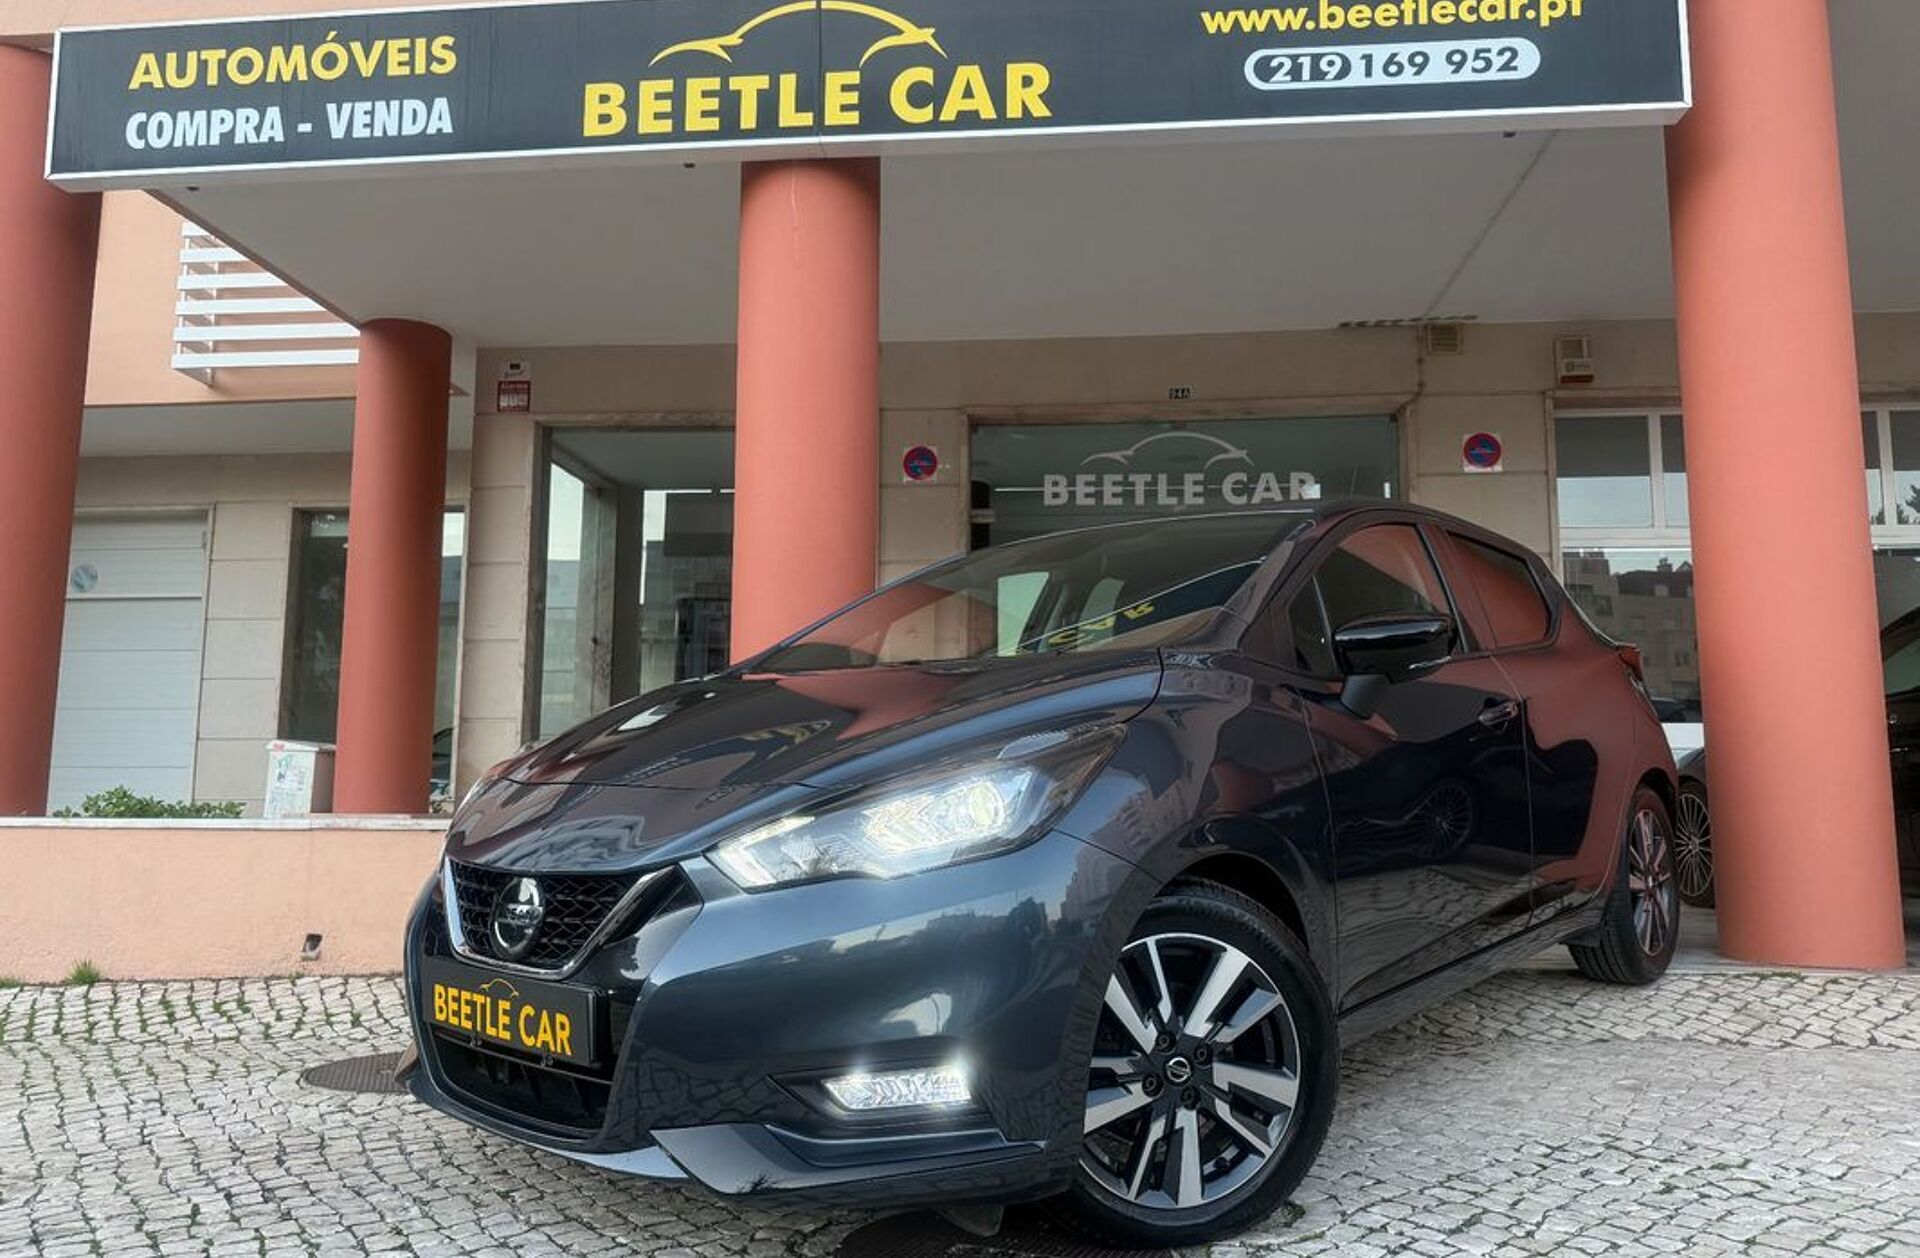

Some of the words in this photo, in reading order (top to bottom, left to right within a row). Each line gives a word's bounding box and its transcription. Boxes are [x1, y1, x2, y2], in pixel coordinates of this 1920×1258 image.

[1201, 0, 1583, 33] www.beetlecar.pt
[128, 32, 457, 90] AUTOMÓVEIS
[1268, 55, 1345, 82] 219
[1362, 52, 1430, 77] 169
[1446, 48, 1518, 74] 952
[126, 106, 285, 150] COMPRA
[326, 97, 454, 140] VENDA
[583, 71, 862, 138] BEETLE
[889, 62, 1052, 125] CAR
[1042, 474, 1205, 506] BEETLE
[1222, 472, 1319, 504] CAR
[433, 984, 511, 1040] BEETLE
[519, 1005, 572, 1056] CAR
